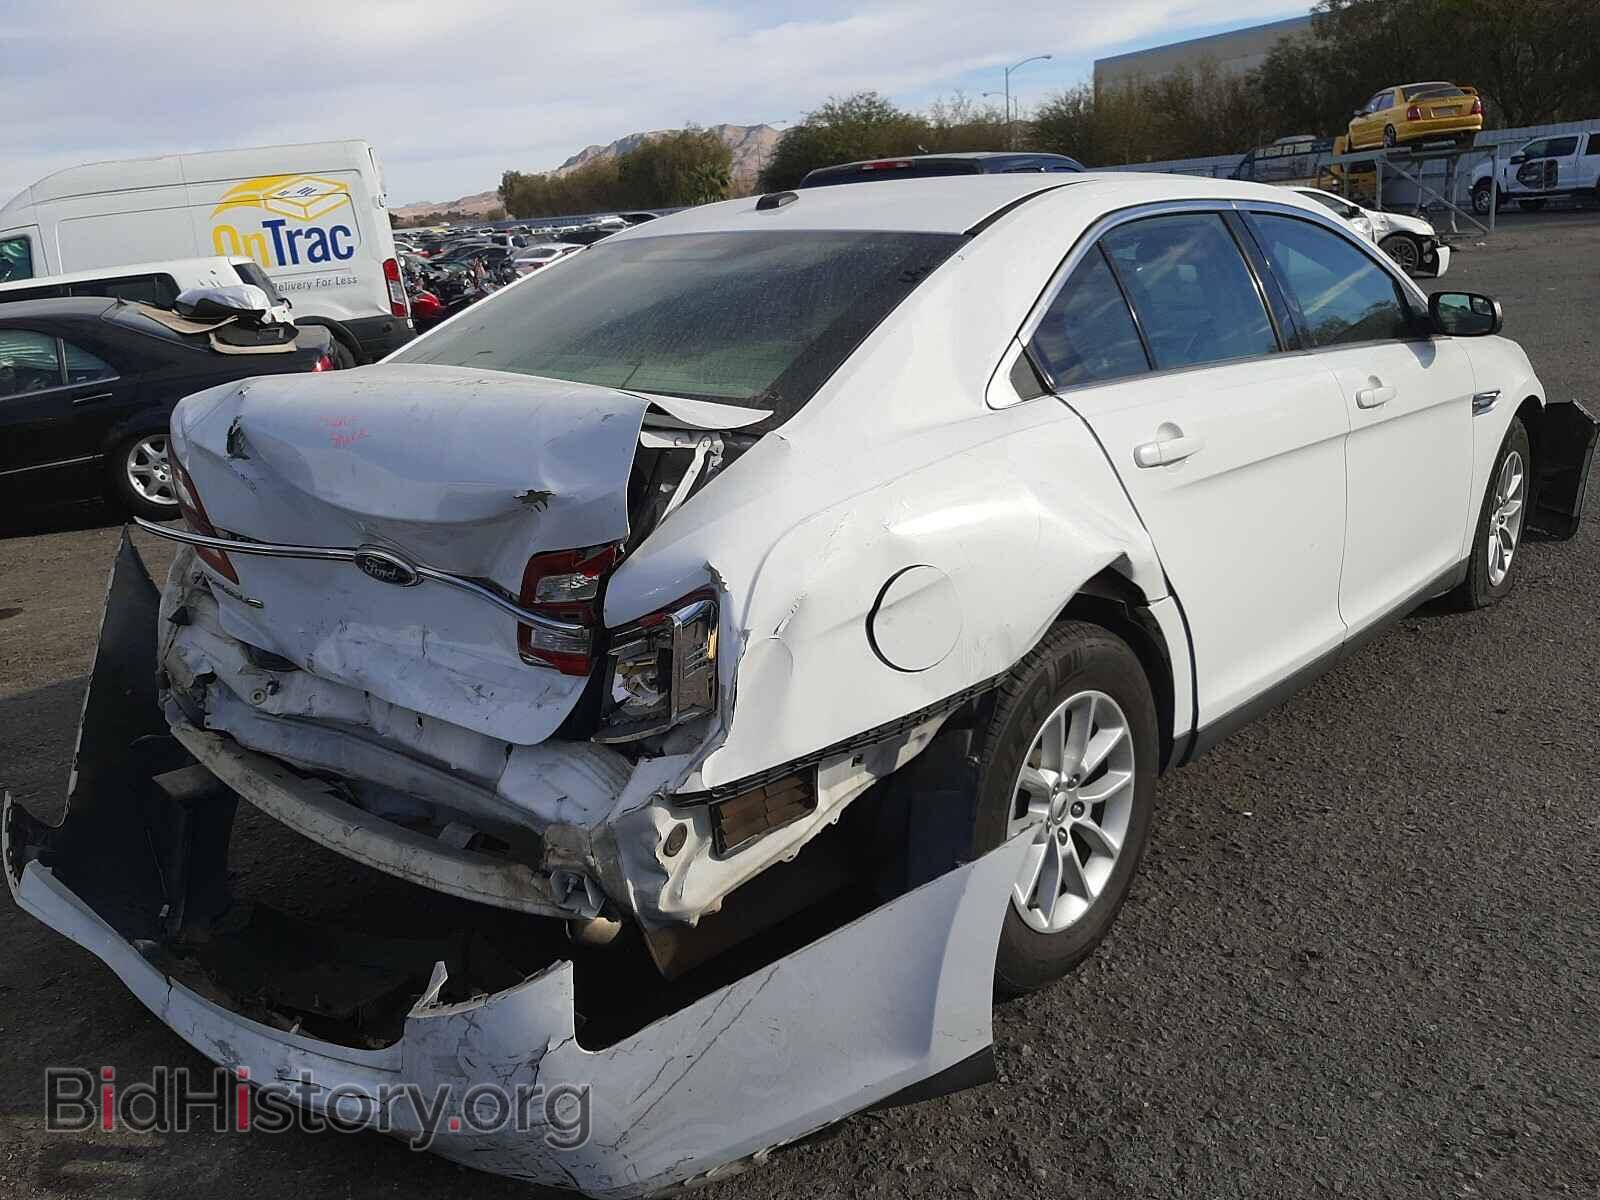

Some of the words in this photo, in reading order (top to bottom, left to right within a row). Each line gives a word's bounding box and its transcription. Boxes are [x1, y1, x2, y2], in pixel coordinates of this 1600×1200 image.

[212, 219, 354, 267] OnTrac
[316, 278, 332, 288] For
[335, 275, 358, 286] Less
[365, 557, 398, 579] Ford
